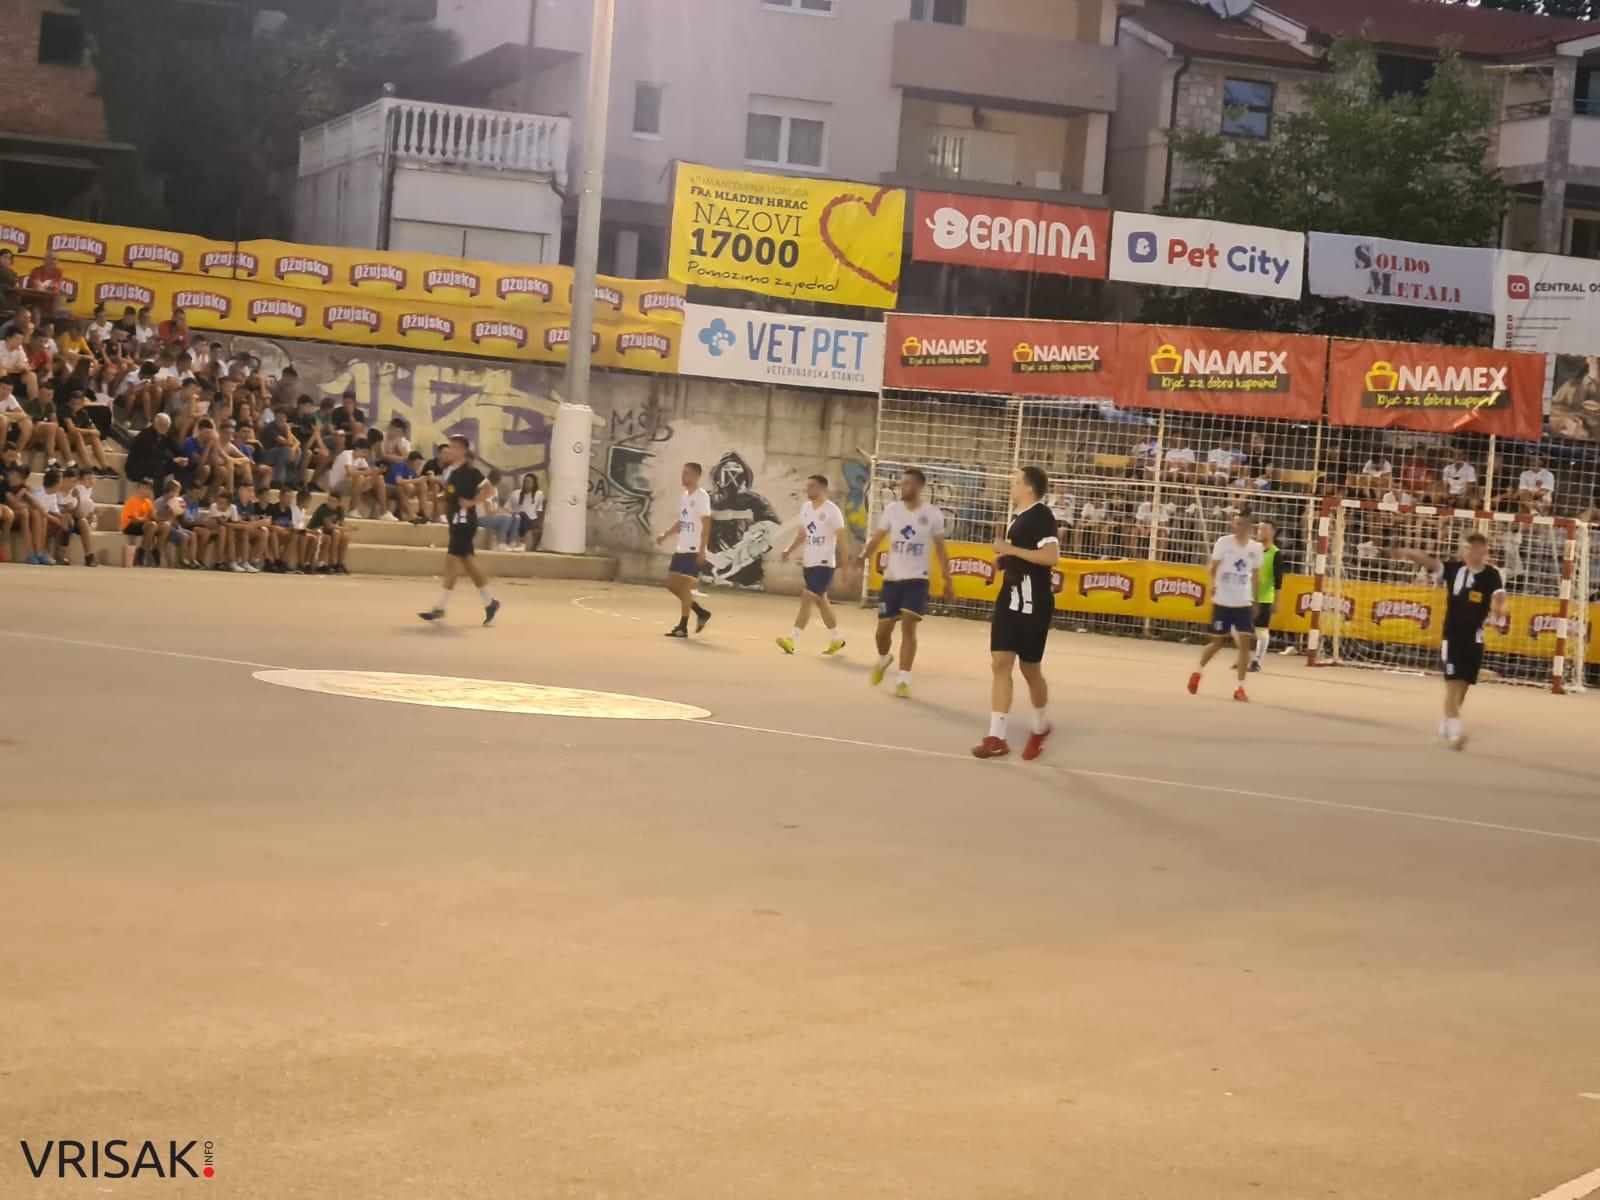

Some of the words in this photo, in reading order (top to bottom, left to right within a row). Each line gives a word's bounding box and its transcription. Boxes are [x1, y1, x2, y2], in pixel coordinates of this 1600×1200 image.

[690, 185, 712, 198] FRA
[714, 190, 764, 205] MLADEN
[692, 201, 802, 237] NAZOVI
[925, 207, 1096, 261] BERNINA
[52, 235, 103, 256] Ožujsko
[129, 245, 179, 264] Ožujsko
[689, 228, 799, 268] 17000
[204, 253, 254, 269] Ožujsko
[280, 258, 329, 277] Ožujsko
[1167, 238, 1220, 269] Pet
[1226, 245, 1290, 285] City
[1354, 244, 1430, 275] SOLDO
[354, 264, 403, 283] Ožujsko
[428, 270, 477, 290] Ožujsko
[687, 260, 770, 285] Pomozimo
[100, 284, 150, 304] Ožujsko
[501, 277, 549, 296] Ožujsko
[1534, 282, 1586, 294] CENTRAL
[177, 292, 227, 312] Ožujsko
[252, 300, 302, 319] Ožujsko
[328, 307, 377, 326] Ožujsko
[402, 314, 451, 334] Ožujsko
[475, 322, 524, 341] Ožujsko
[621, 333, 667, 352] Ožujsko
[747, 320, 806, 364] VET
[811, 327, 869, 371] PET
[921, 339, 987, 356] NAMEX
[1033, 345, 1099, 362] NAMEX
[1183, 348, 1288, 375] NAMEX
[1398, 365, 1508, 391] NAMEX
[1083, 574, 1130, 592] Ožujsko
[1154, 578, 1202, 598] Ožujsko
